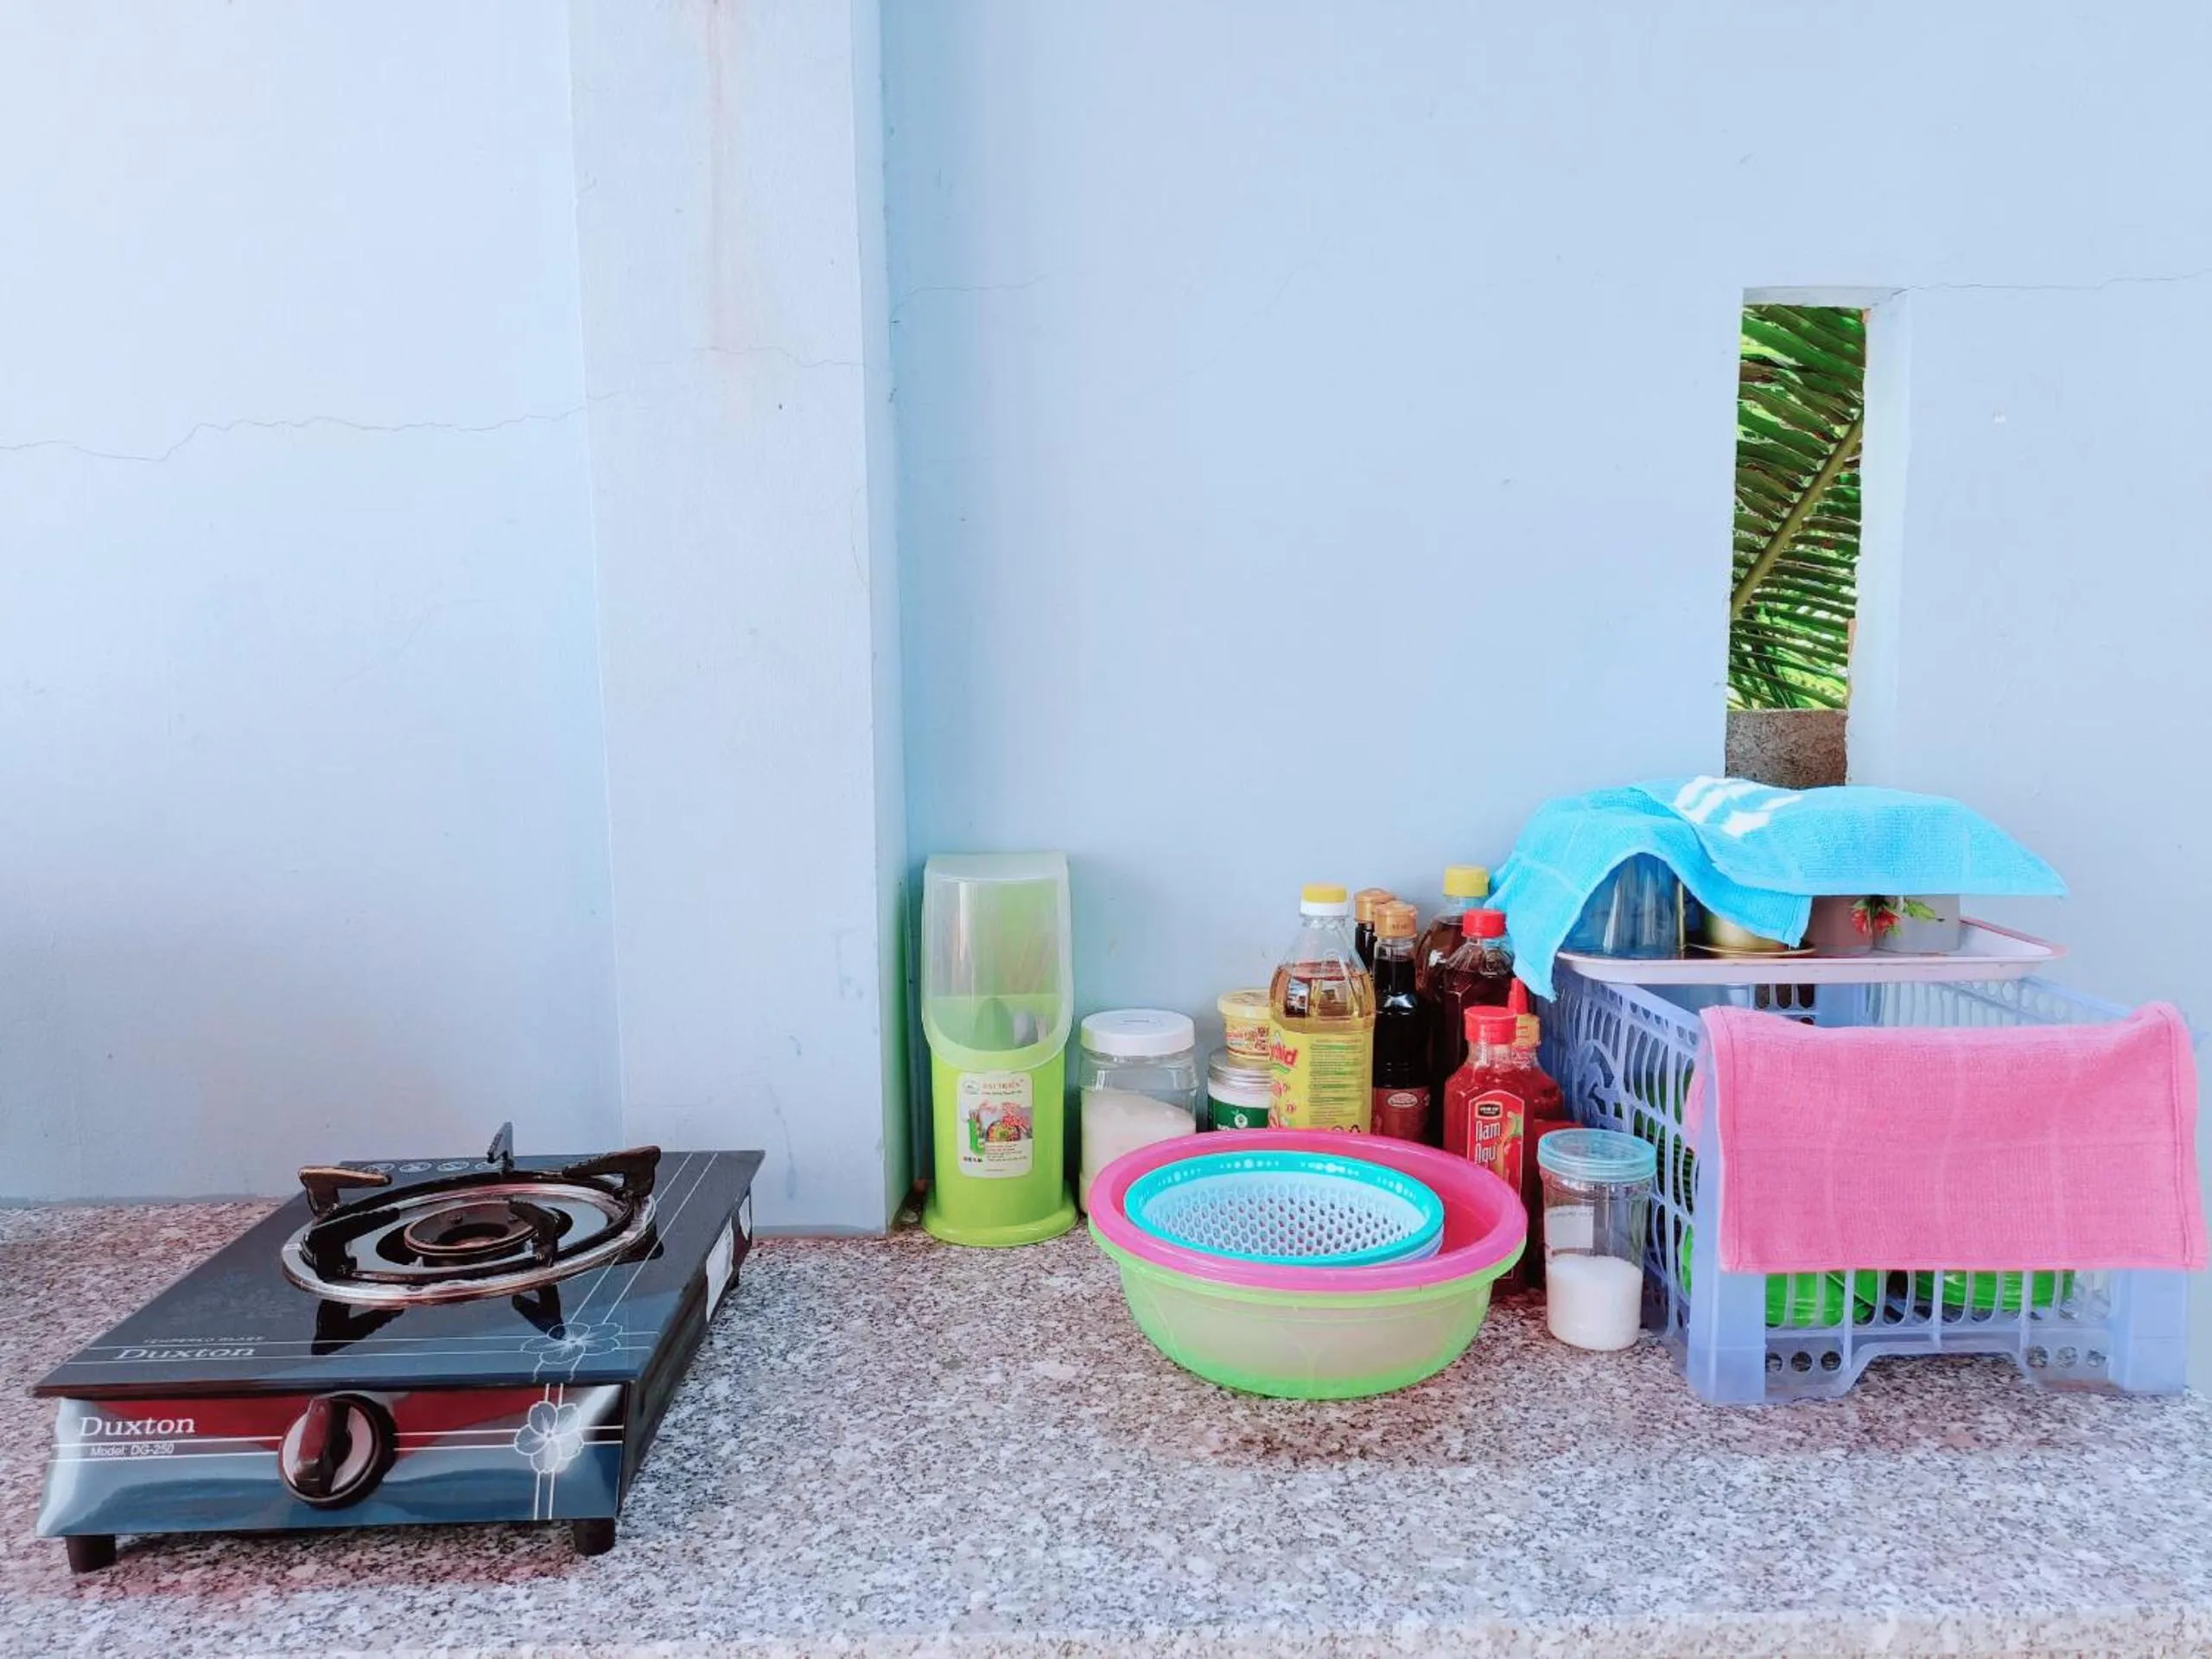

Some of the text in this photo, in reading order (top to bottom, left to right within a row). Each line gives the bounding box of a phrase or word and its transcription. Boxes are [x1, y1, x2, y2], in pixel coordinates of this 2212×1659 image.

[114, 1347, 255, 1360] Duxton
[79, 1416, 195, 1436] Duxton
[130, 1441, 175, 1456] DG-250
